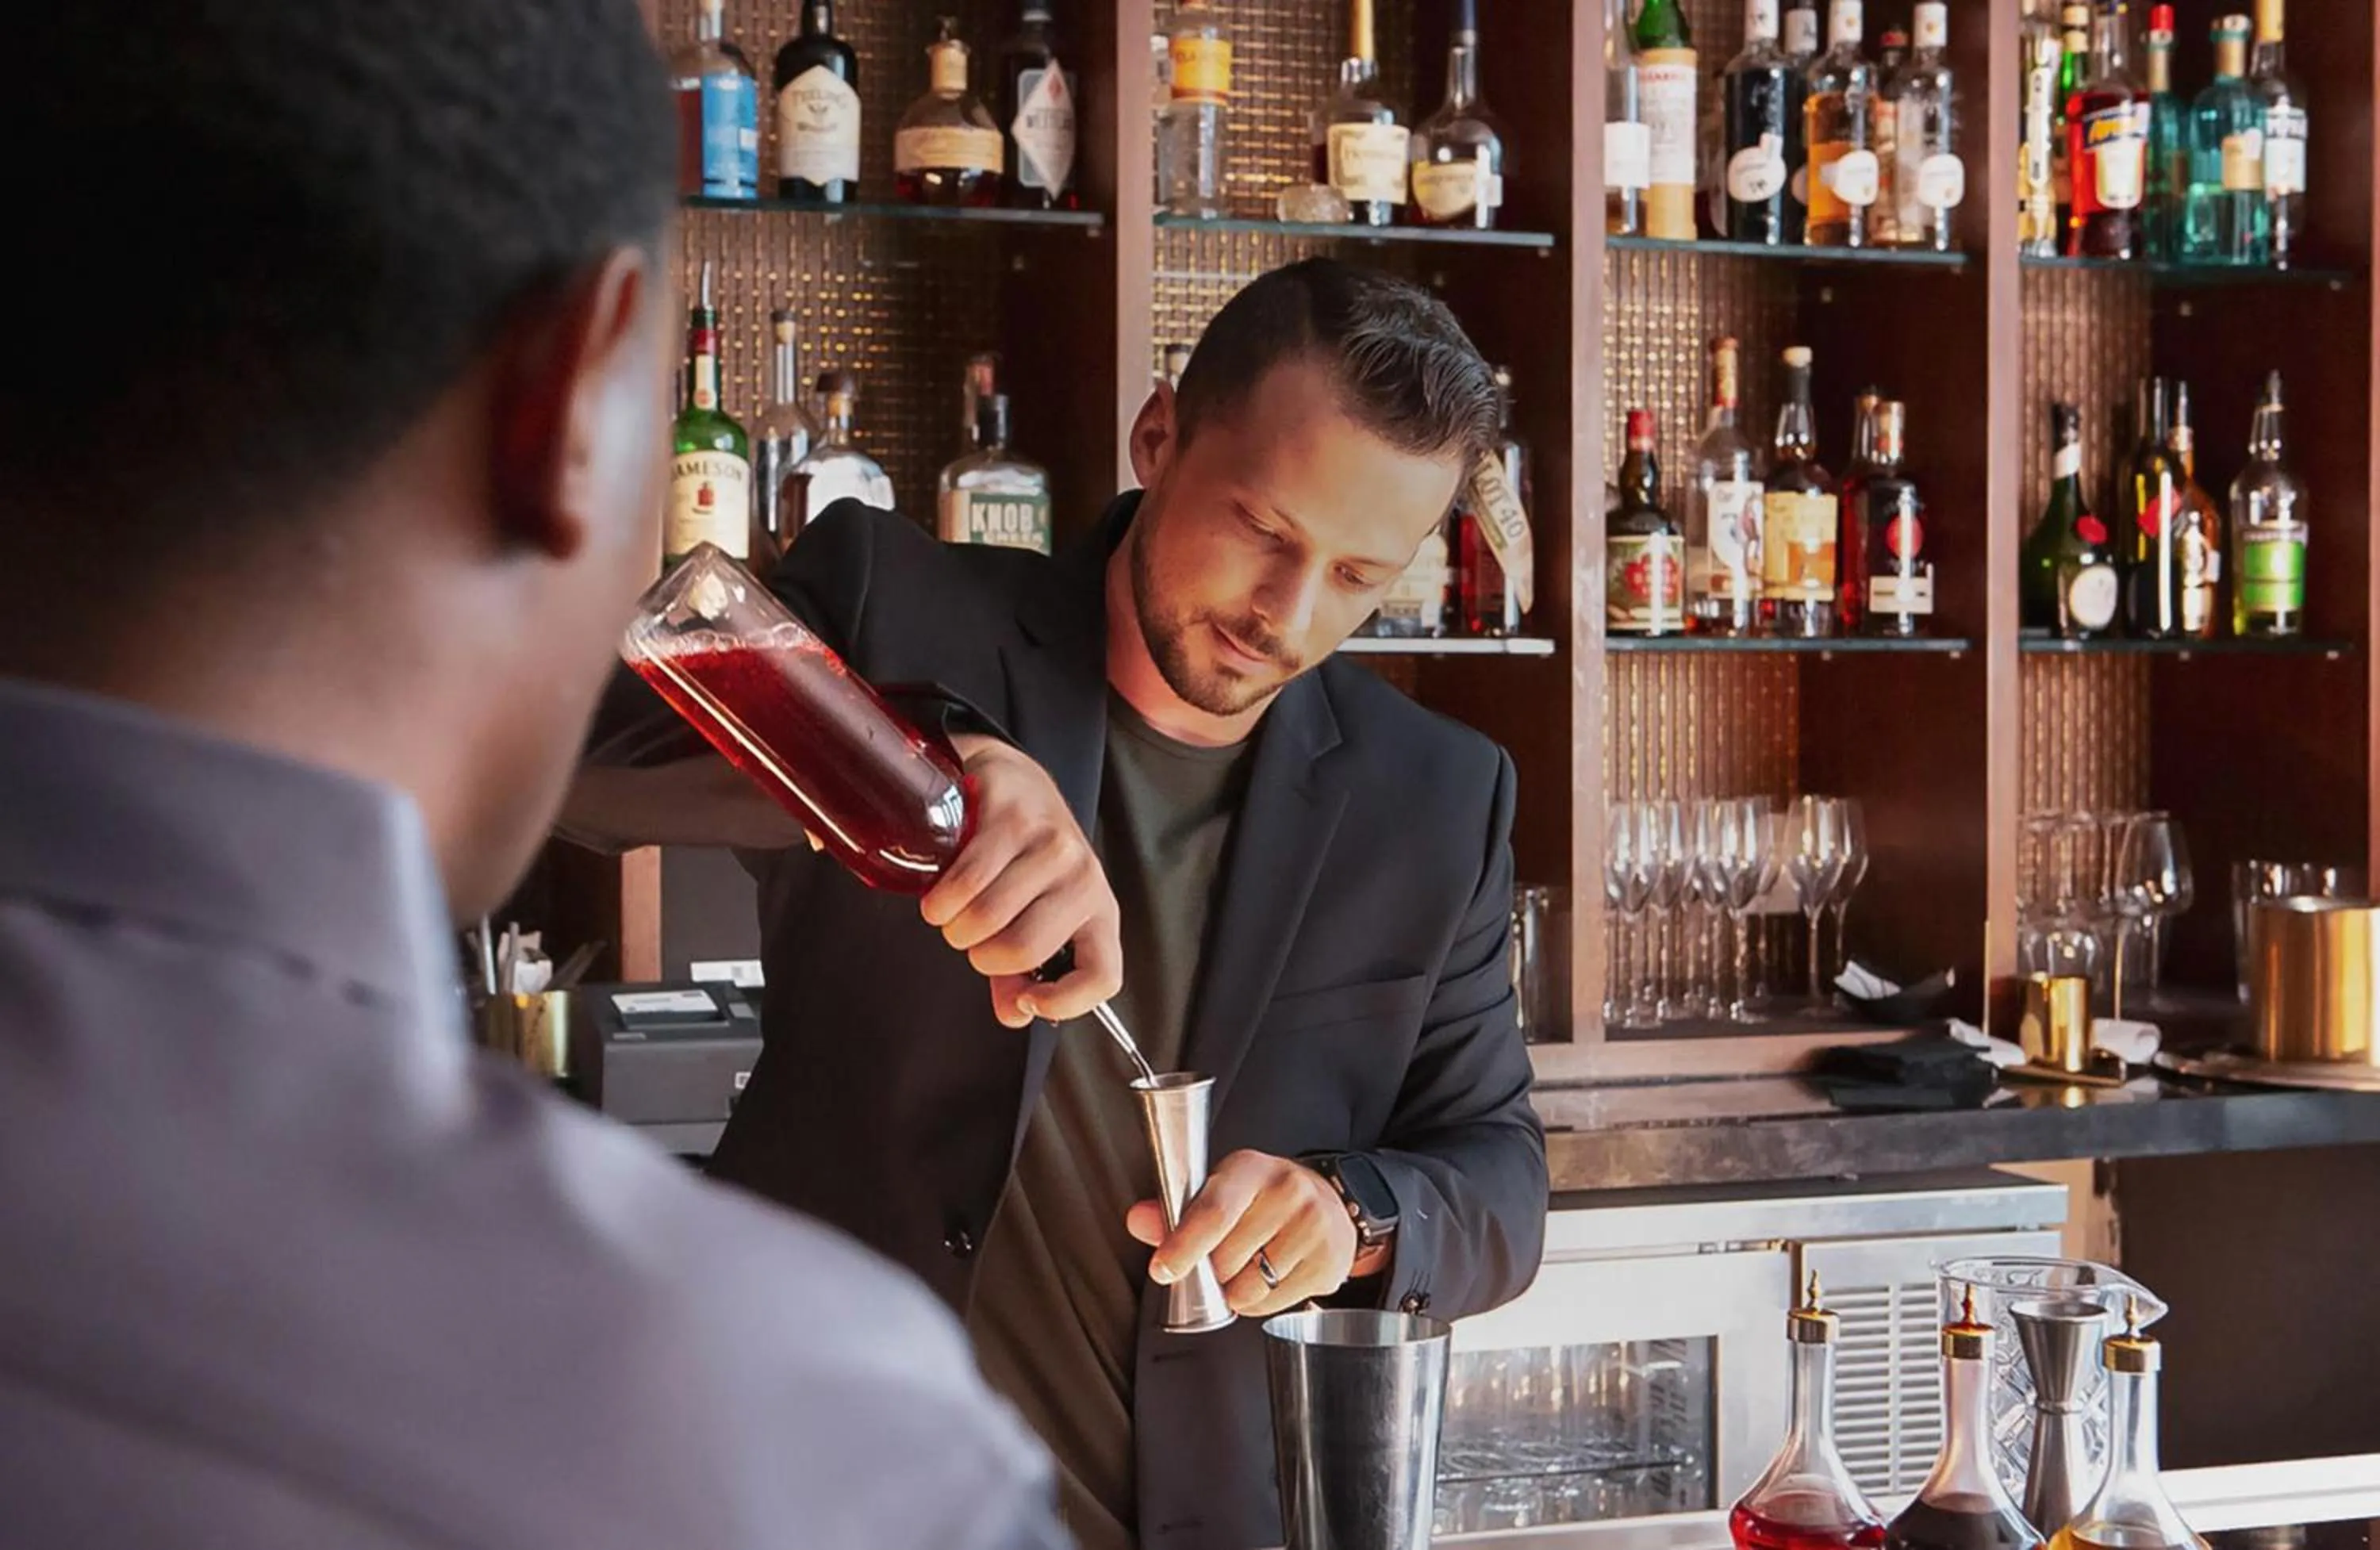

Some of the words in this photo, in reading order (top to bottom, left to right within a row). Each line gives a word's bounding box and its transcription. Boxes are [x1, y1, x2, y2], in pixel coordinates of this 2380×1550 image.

[670, 461, 742, 482] JAMESON
[971, 502, 1033, 532] KNOB
[1499, 508, 1525, 538] 40
